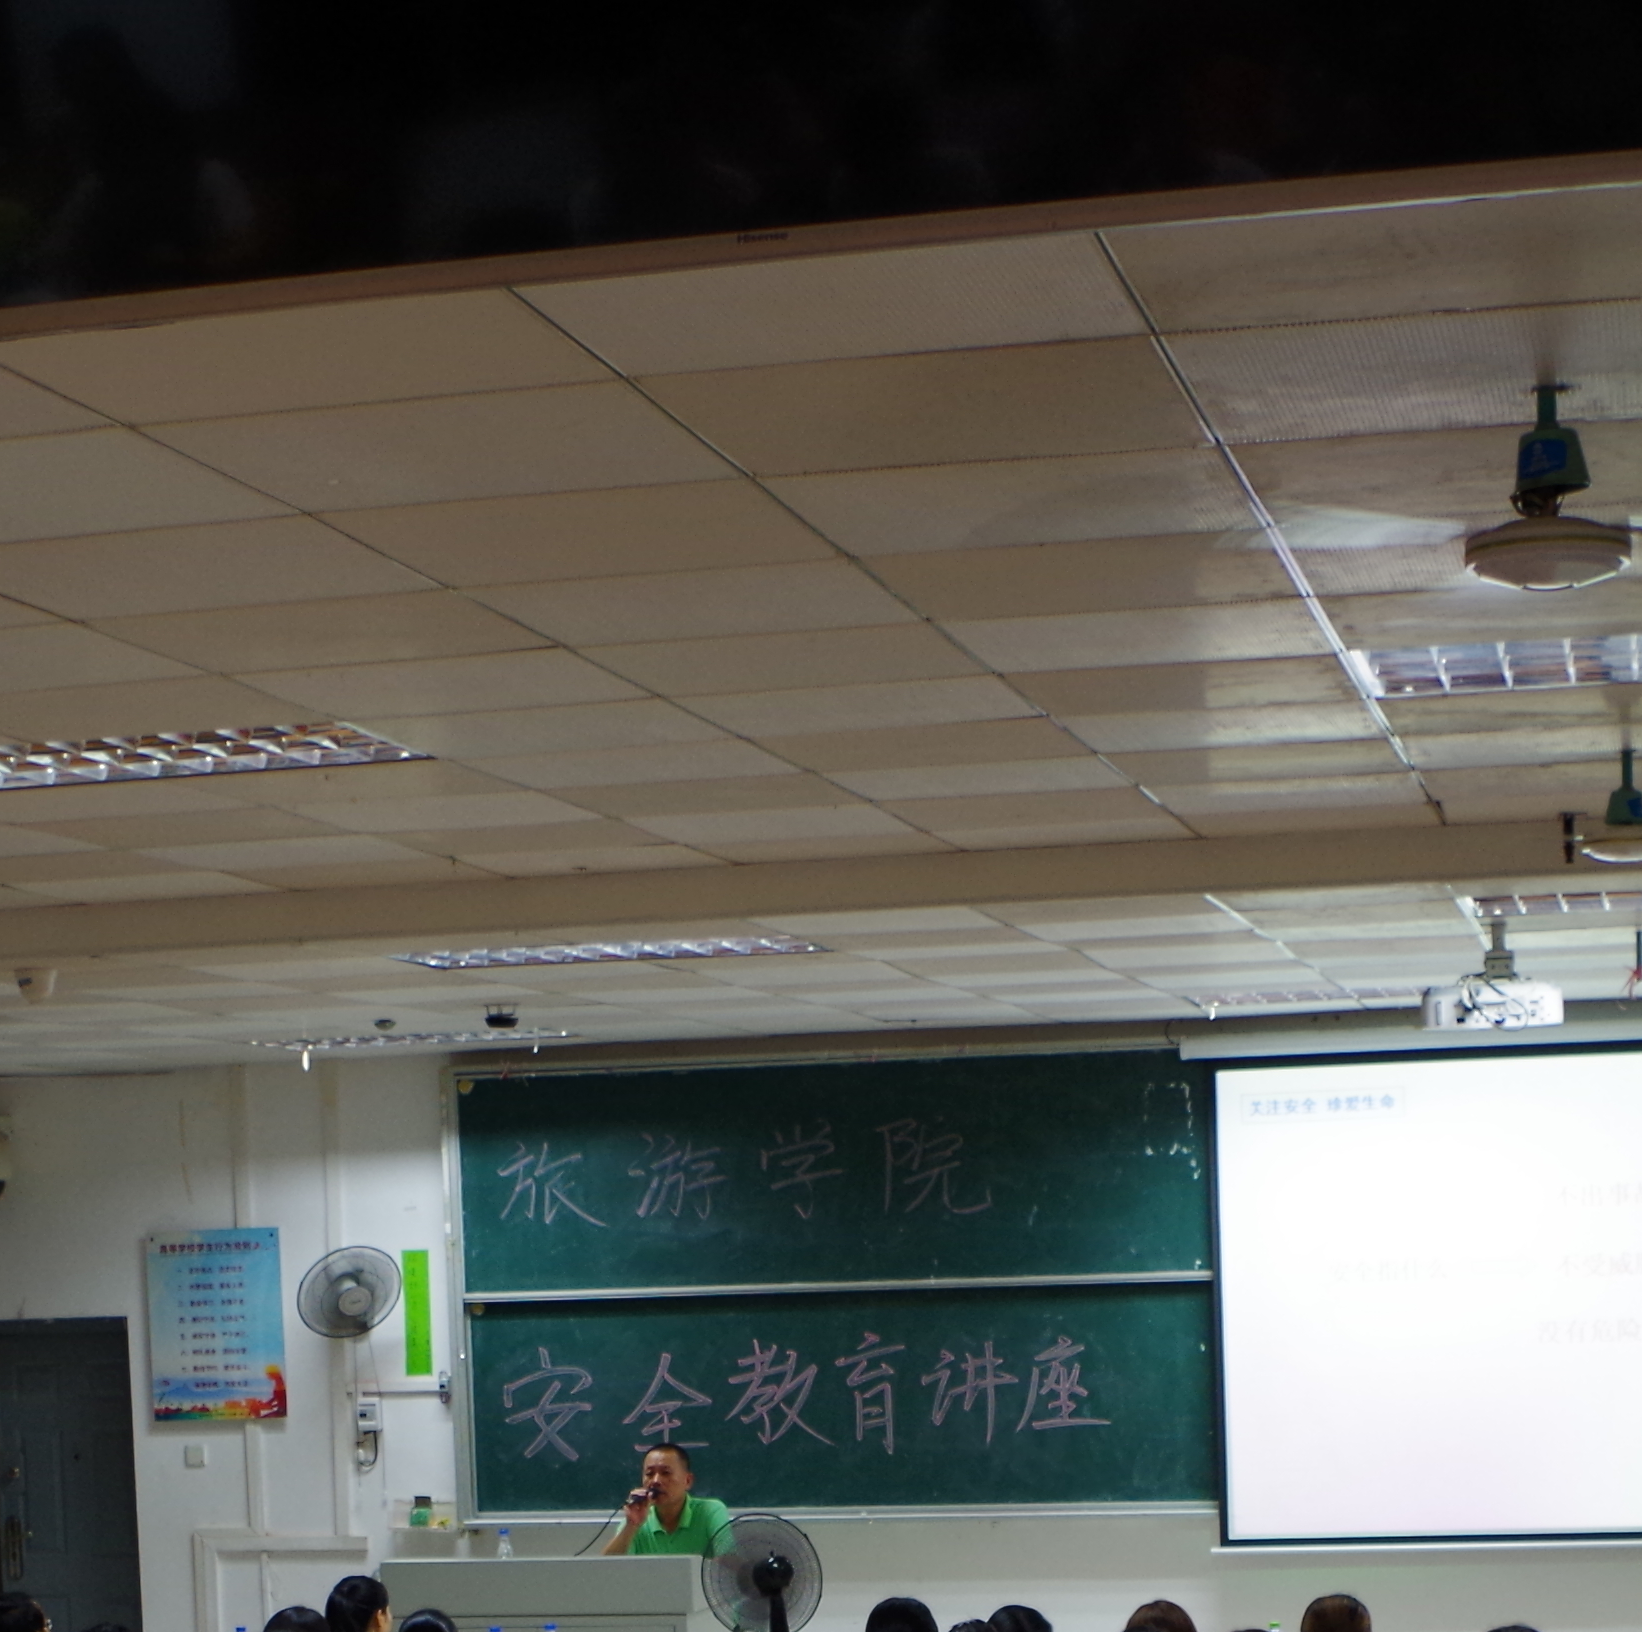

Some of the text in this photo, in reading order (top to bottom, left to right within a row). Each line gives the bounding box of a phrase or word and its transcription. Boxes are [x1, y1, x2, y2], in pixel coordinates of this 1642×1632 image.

[1248, 1094, 1318, 1116] 关注安全
[496, 1117, 992, 1228] 旅游学院
[502, 1332, 1112, 1461] 安全教育讲座
